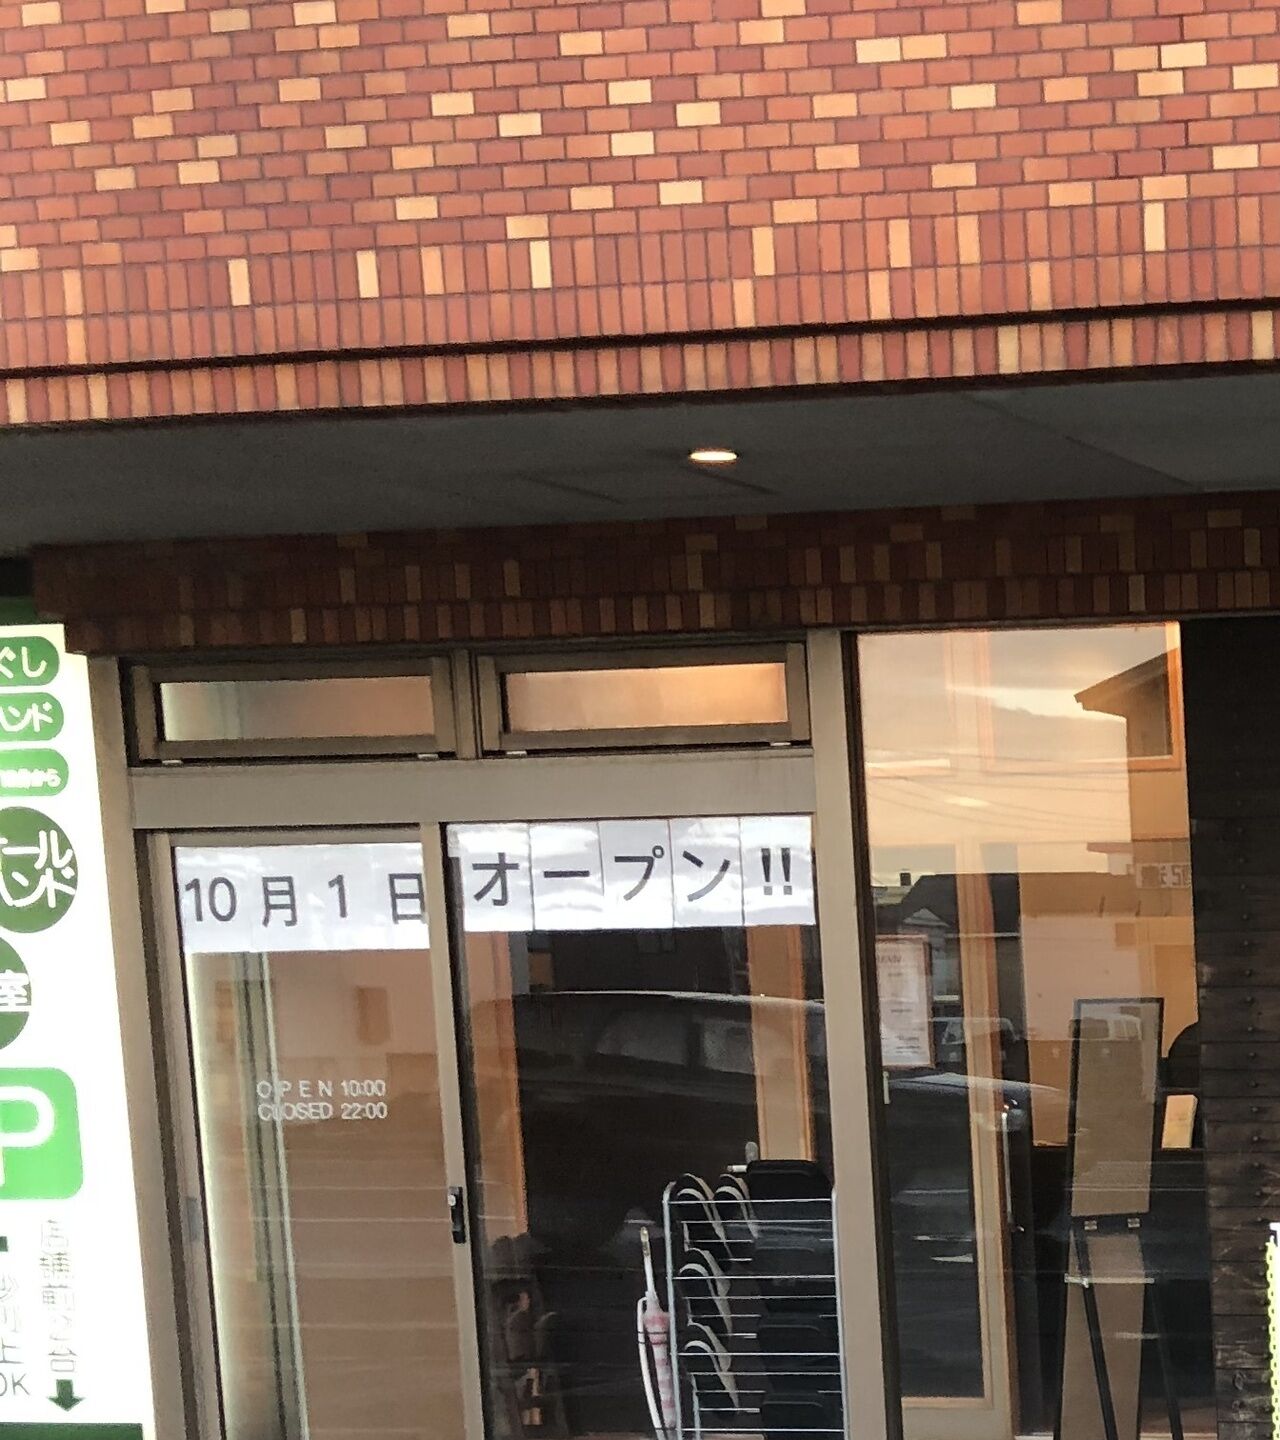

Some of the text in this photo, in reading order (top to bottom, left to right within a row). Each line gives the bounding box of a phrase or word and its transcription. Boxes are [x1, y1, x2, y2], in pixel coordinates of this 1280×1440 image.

[256, 1080, 387, 1098] OPEN 10:00
[258, 1102, 388, 1121] CLOSED 22:00
